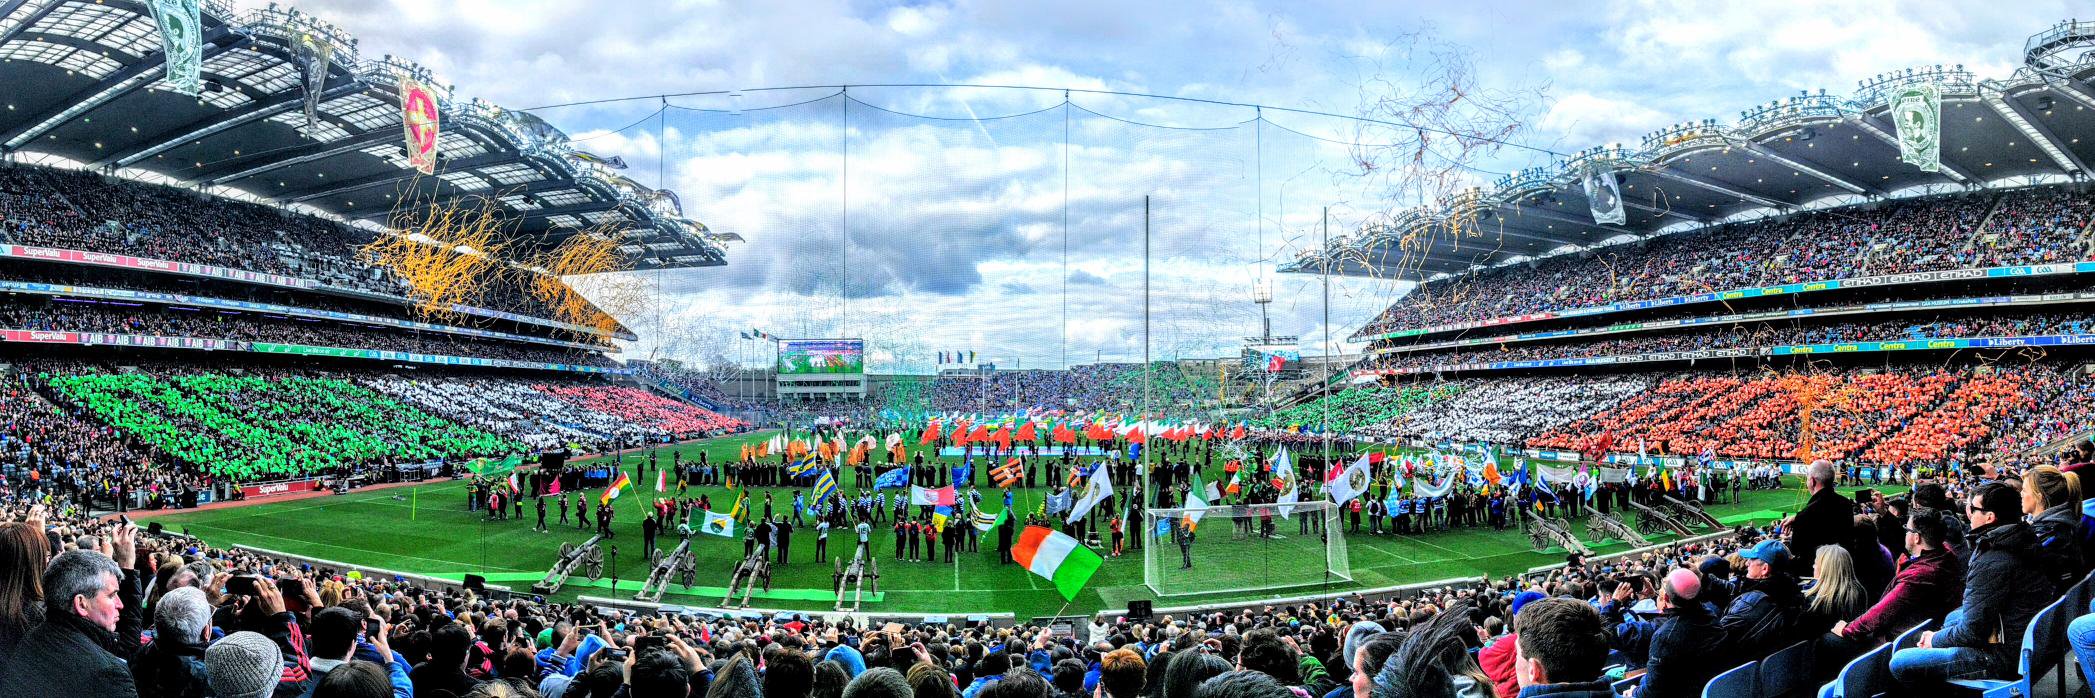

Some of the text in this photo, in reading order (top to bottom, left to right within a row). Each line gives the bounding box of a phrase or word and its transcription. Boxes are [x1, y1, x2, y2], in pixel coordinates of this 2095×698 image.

[23, 247, 60, 258] SuperValu
[83, 252, 117, 262] SuperValu
[137, 258, 169, 268] SuperValu
[189, 264, 200, 273] AIB
[212, 266, 222, 275] AIB
[234, 269, 245, 278] AIB
[256, 272, 266, 281] AIB
[1890, 273, 1931, 283] ETIHAD
[1940, 270, 1983, 279] ETIHAD
[1843, 277, 1881, 287] ETIHAD
[1762, 287, 1783, 295] Centra
[1803, 283, 1826, 291] Centra
[31, 331, 67, 342] SuperValu
[89, 334, 103, 343] AIB
[115, 335, 129, 344] AIB
[142, 336, 156, 346] AIB
[166, 337, 179, 346] AIB
[191, 339, 204, 348] AIB
[213, 340, 225, 349] AIB
[1879, 342, 1905, 350] Centra
[1928, 340, 1955, 348] Centra
[1994, 338, 2025, 346] Liberty
[1790, 346, 1813, 354] Centra
[1833, 344, 1858, 352] Centra
[1682, 351, 1710, 359] ETIHAD
[1716, 349, 1747, 357] ETIHAD
[259, 483, 289, 495] SuperValu
